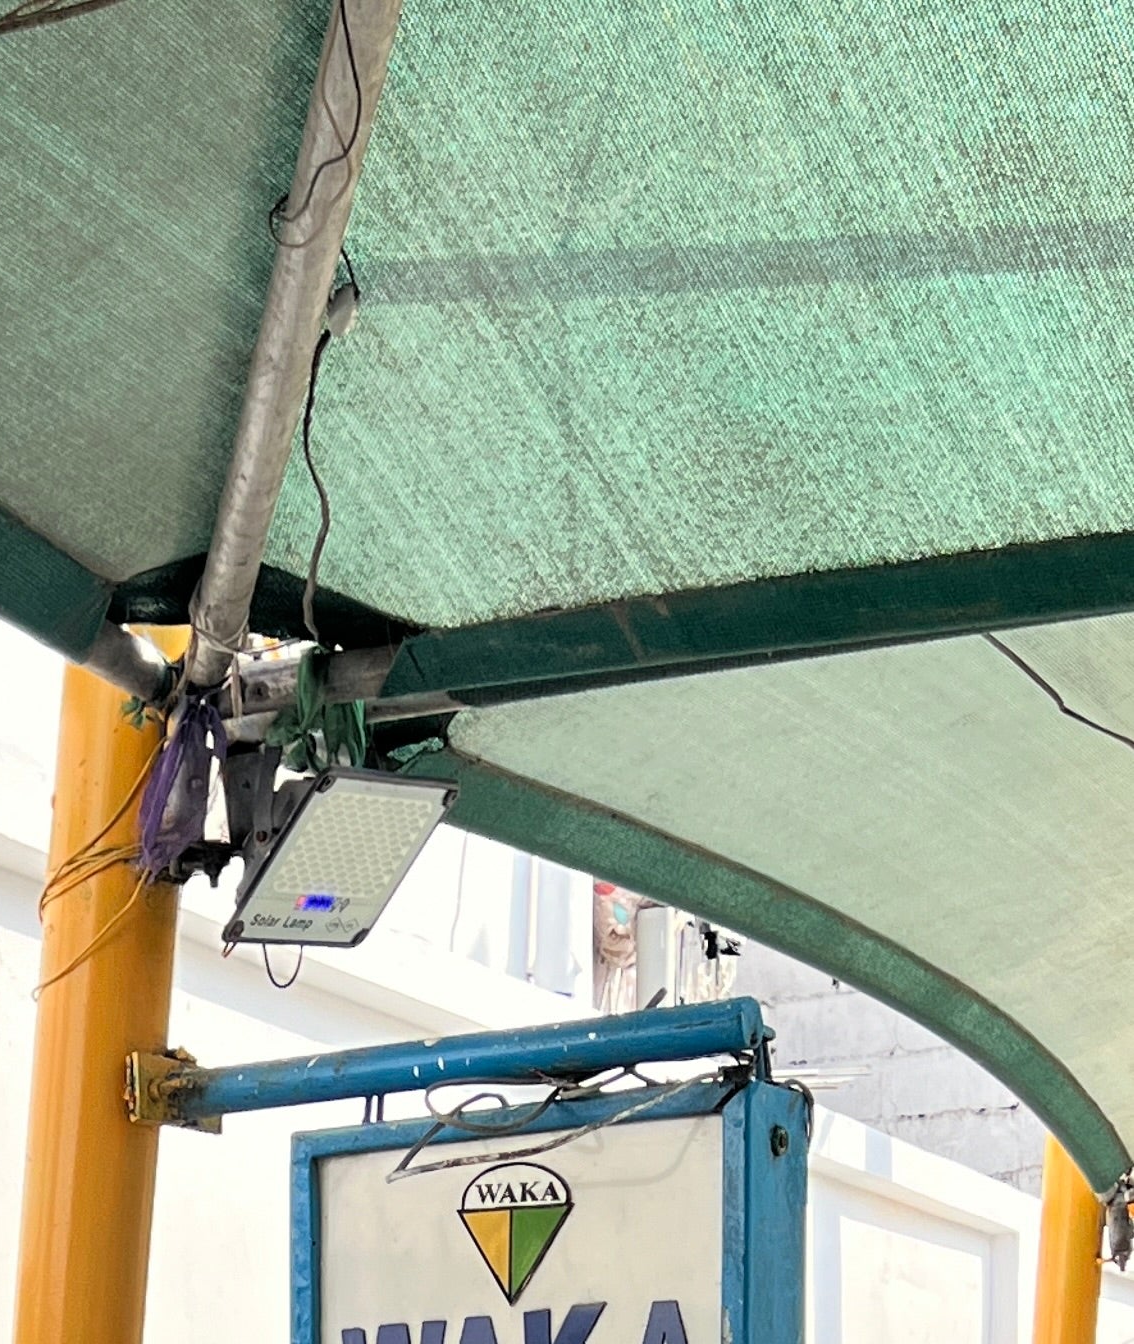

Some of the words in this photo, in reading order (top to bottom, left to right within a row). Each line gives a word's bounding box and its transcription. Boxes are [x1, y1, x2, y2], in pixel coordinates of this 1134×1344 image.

[250, 913, 281, 926] Solar
[282, 916, 313, 931] Lamp
[475, 1180, 560, 1204] WAKA
